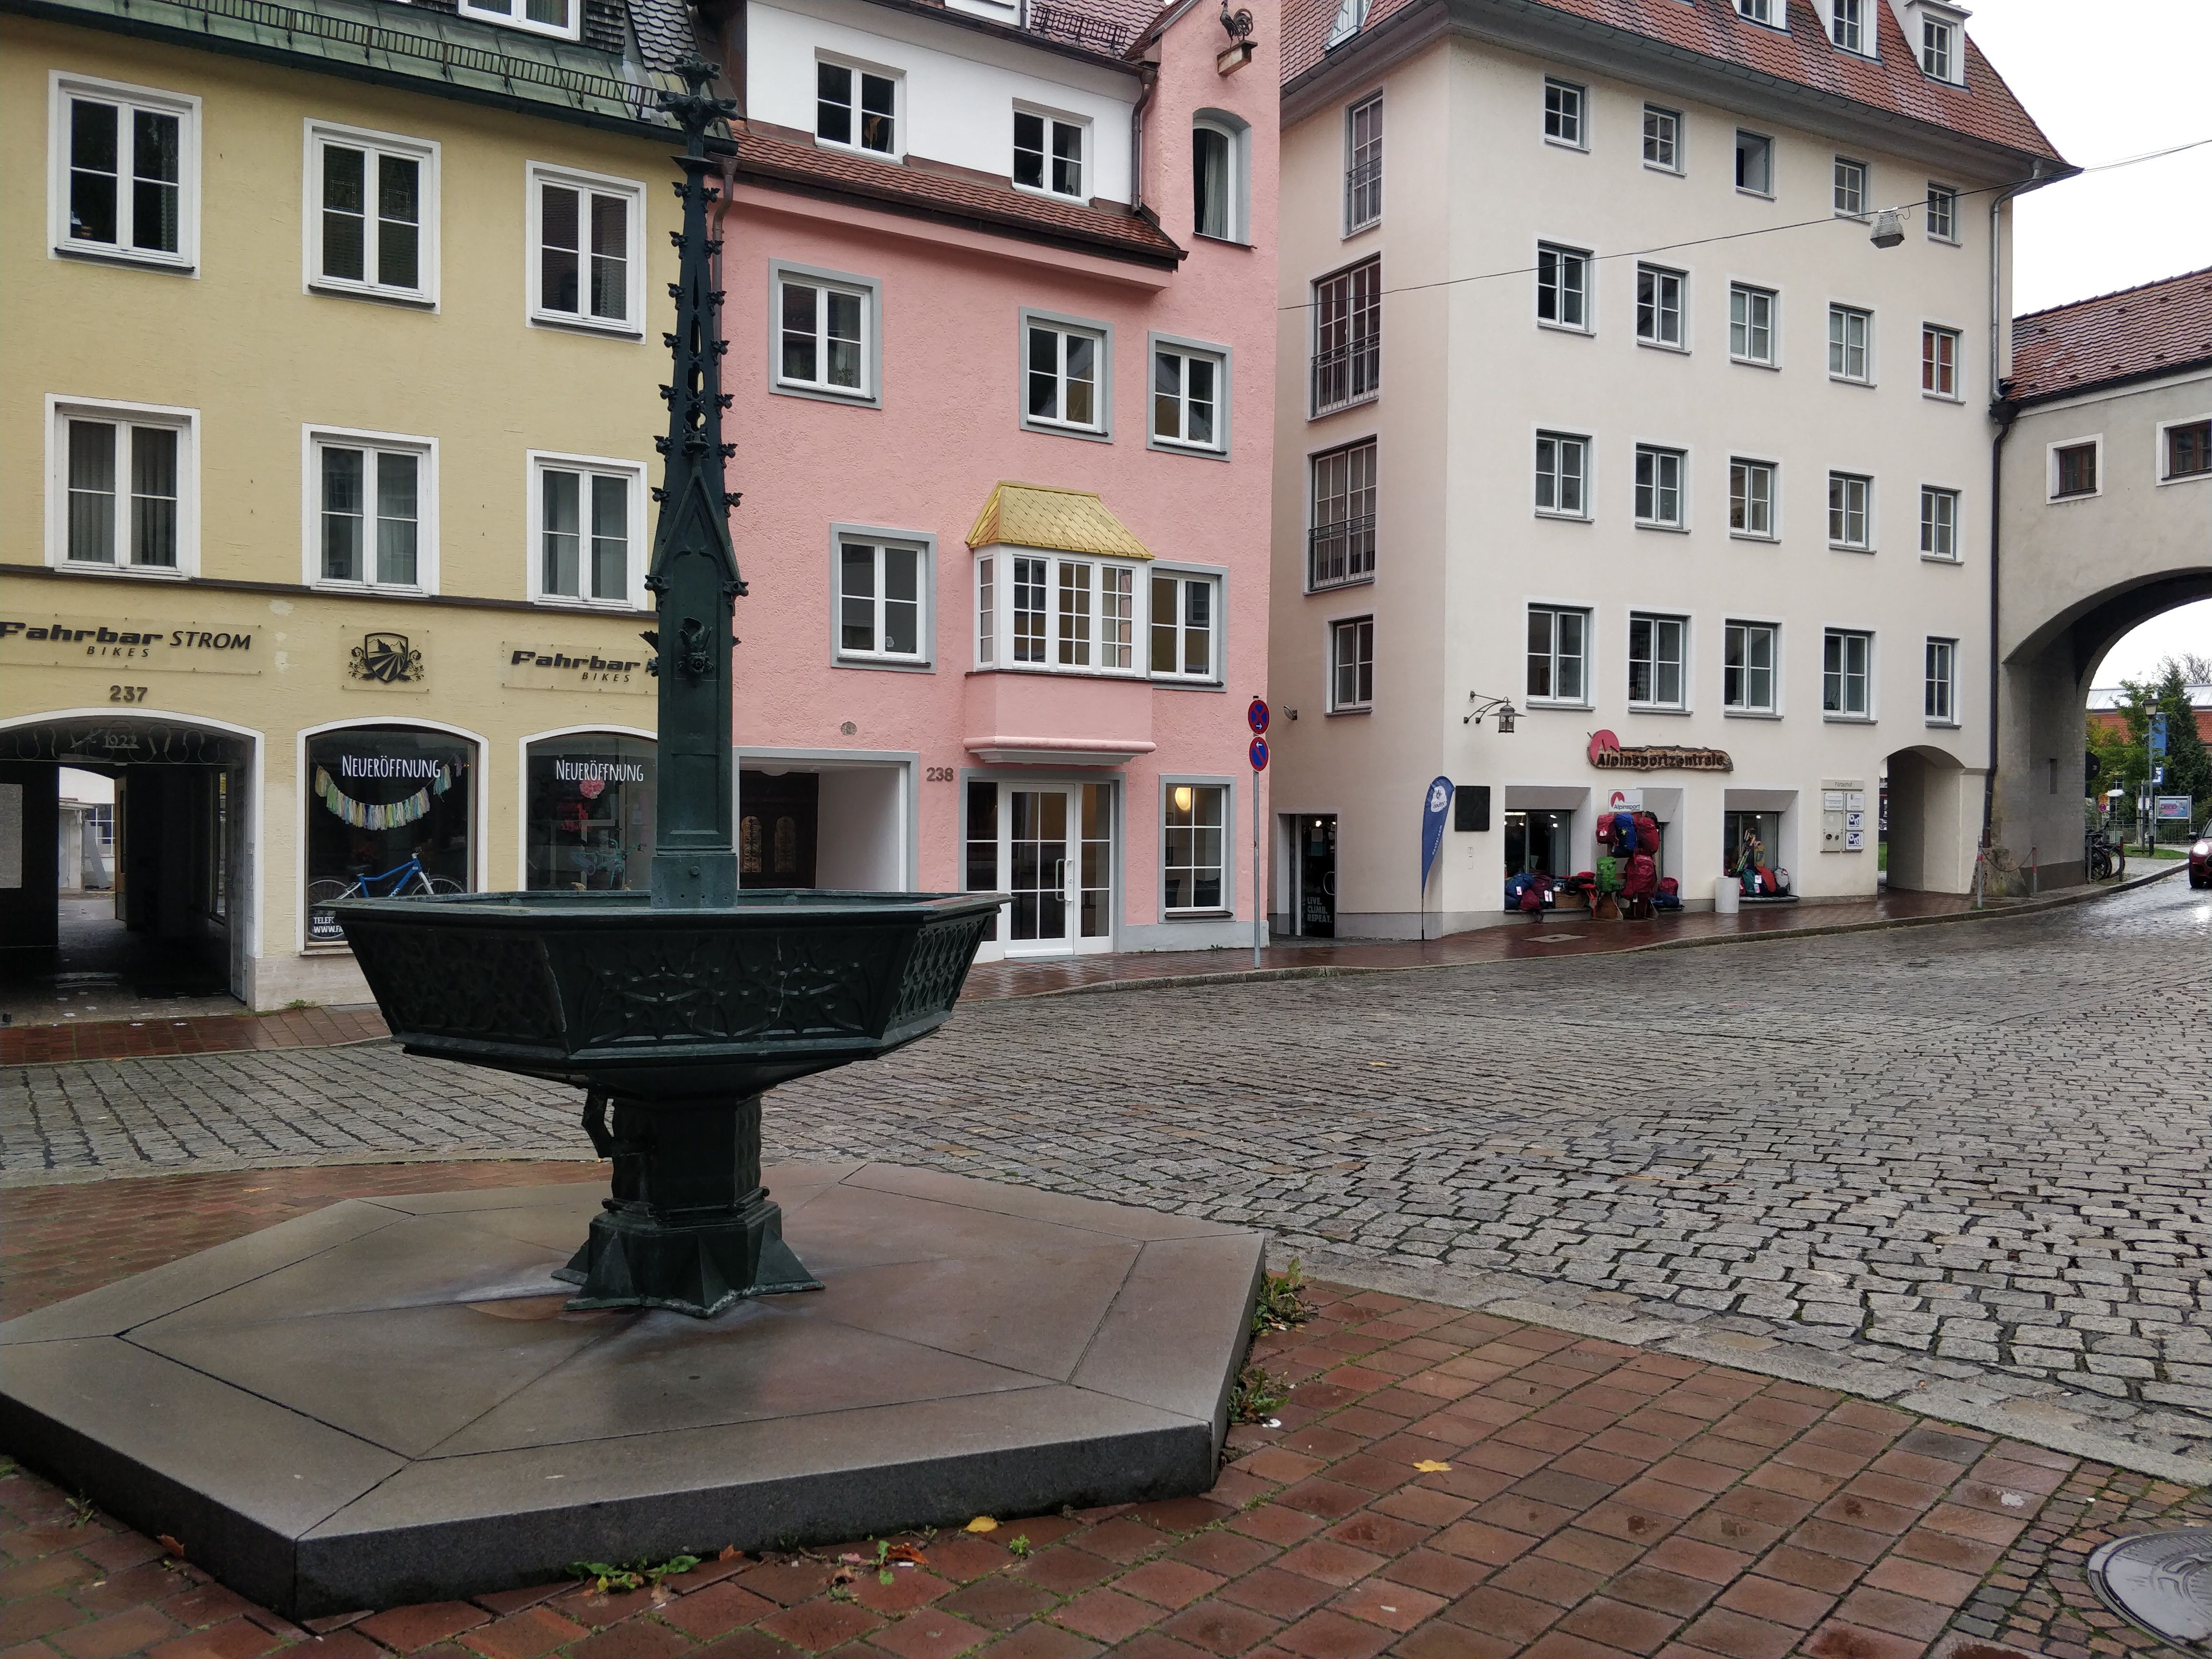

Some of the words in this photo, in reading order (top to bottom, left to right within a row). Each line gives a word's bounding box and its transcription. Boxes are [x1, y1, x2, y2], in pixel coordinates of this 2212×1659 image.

[0, 622, 163, 644] Fahrbar
[169, 630, 252, 650] STROM
[87, 646, 150, 657] BIKES
[511, 650, 641, 671] Fahrbar
[582, 672, 630, 682] BIKES
[109, 685, 148, 702] 237
[104, 734, 138, 747] 1922
[342, 755, 441, 778] NEUERÖFFNUNG
[1596, 753, 1724, 768] Alpinsportzentrale
[556, 759, 644, 782] NEUERÖFFNUNG
[926, 767, 954, 782] 238
[1307, 897, 1322, 905] LIVE.
[1307, 905, 1328, 914] CLIMB.
[1307, 914, 1332, 923] REPEAT.
[313, 925, 343, 933] WWW.FA
